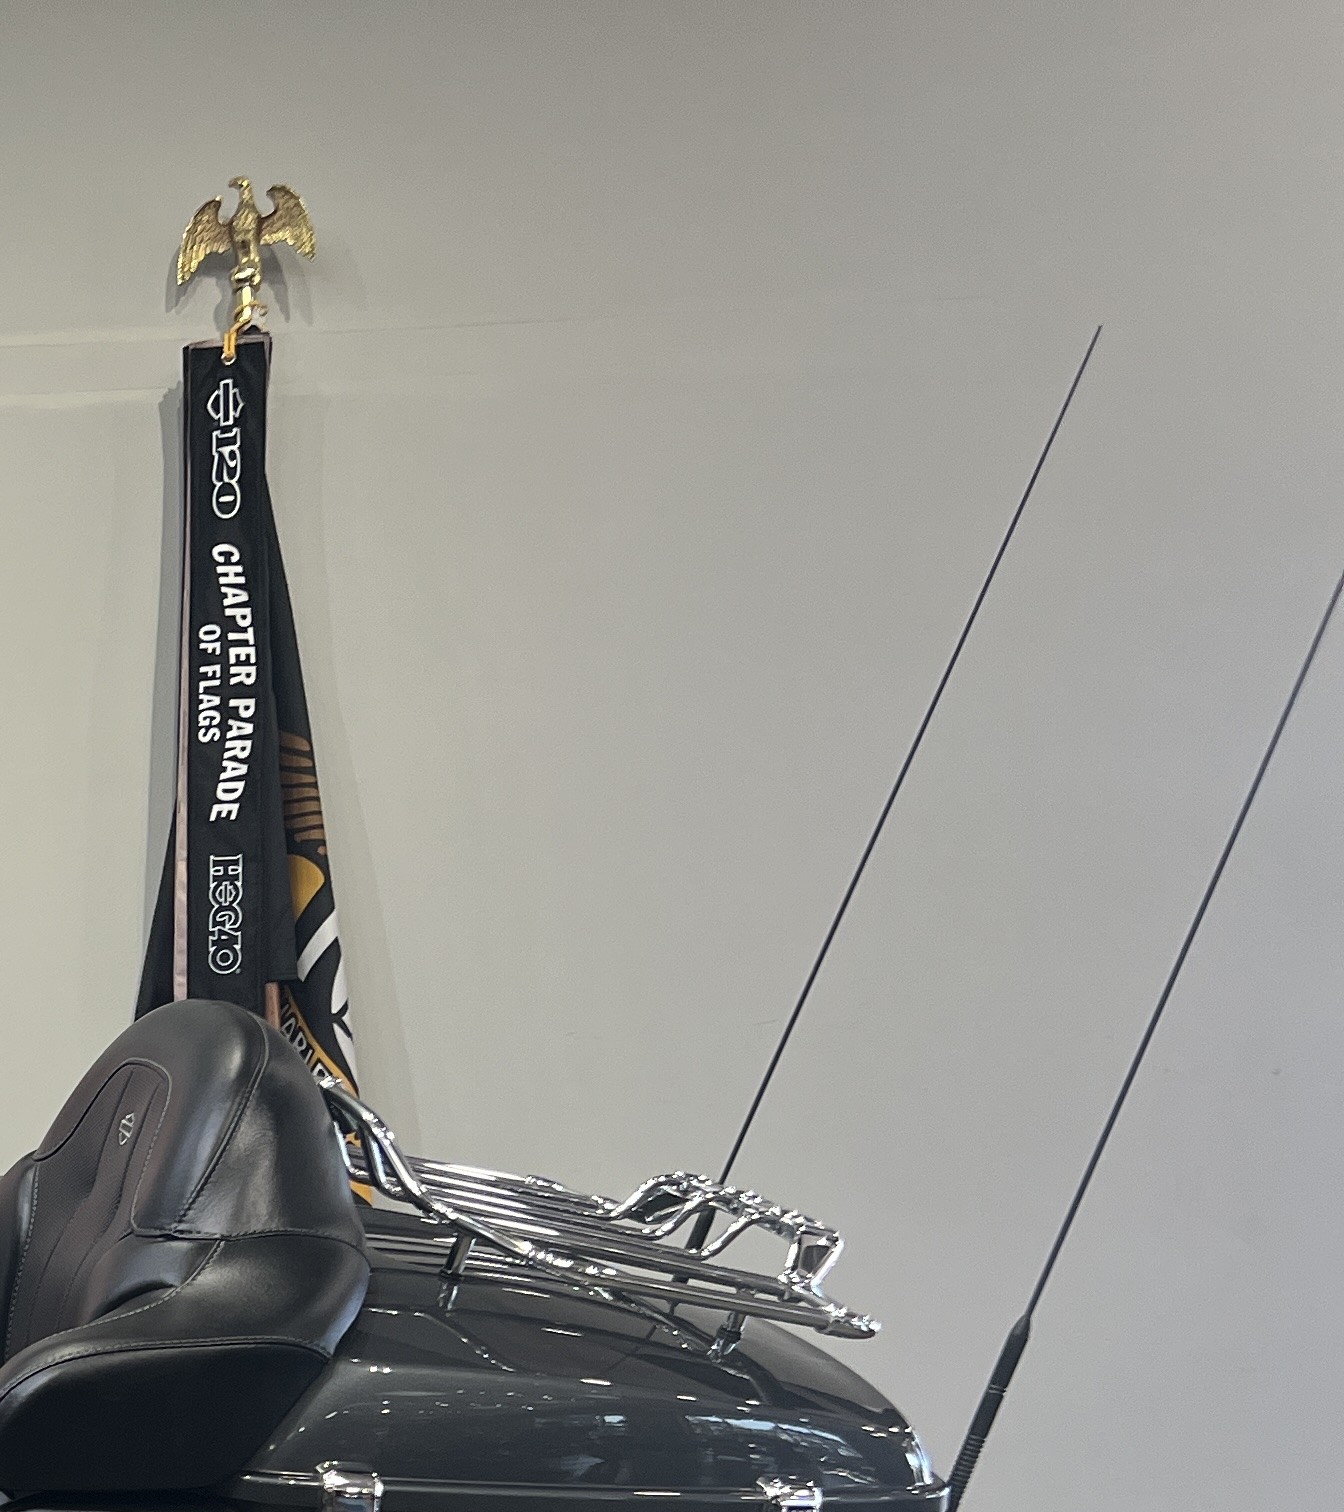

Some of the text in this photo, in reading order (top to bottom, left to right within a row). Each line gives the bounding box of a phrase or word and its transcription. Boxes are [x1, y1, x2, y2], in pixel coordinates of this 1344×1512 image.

[198, 623, 221, 743] OF FLAGS
[209, 543, 256, 822] CHAPTER PARADE
